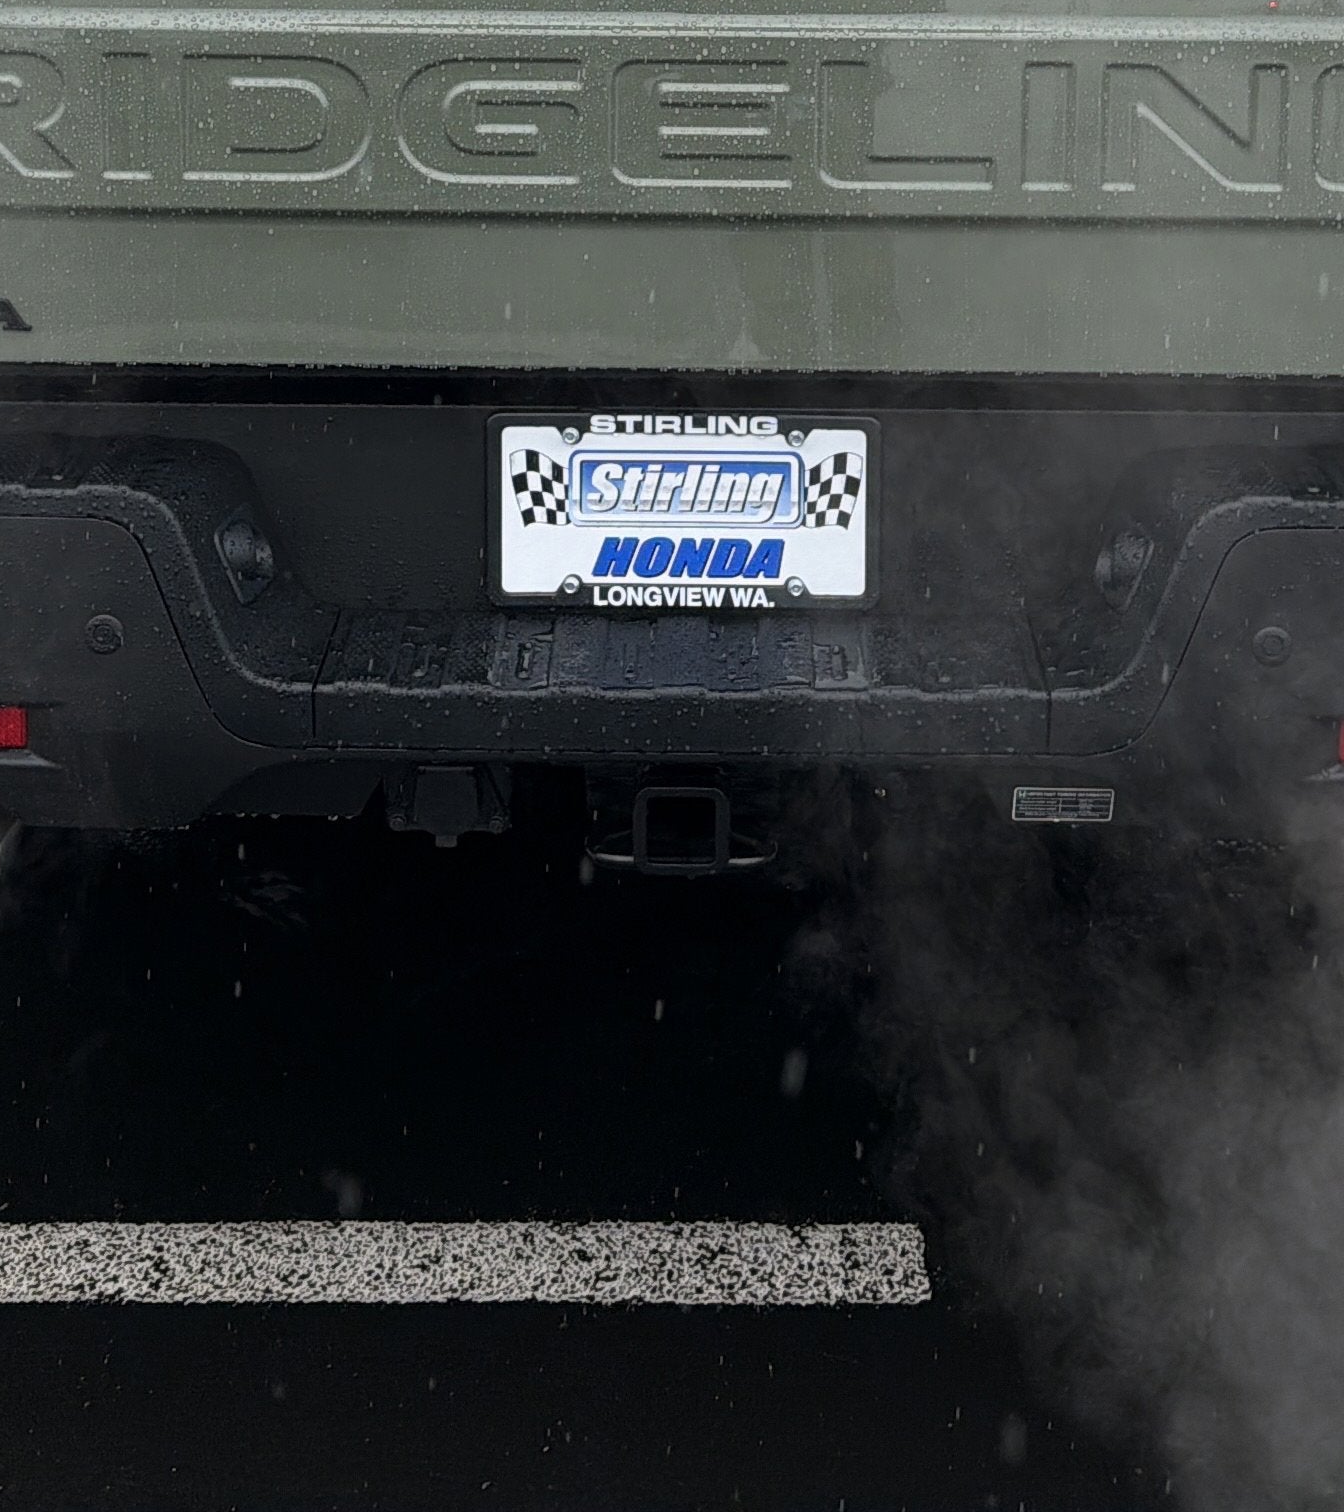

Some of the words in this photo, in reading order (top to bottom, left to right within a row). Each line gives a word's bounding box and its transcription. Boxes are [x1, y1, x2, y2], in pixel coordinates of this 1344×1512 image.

[588, 414, 779, 436] STIRLING
[586, 462, 785, 524] Stirling
[592, 536, 786, 579] HONDA
[593, 586, 724, 607] LONGVIEW
[731, 586, 776, 609] WA.
